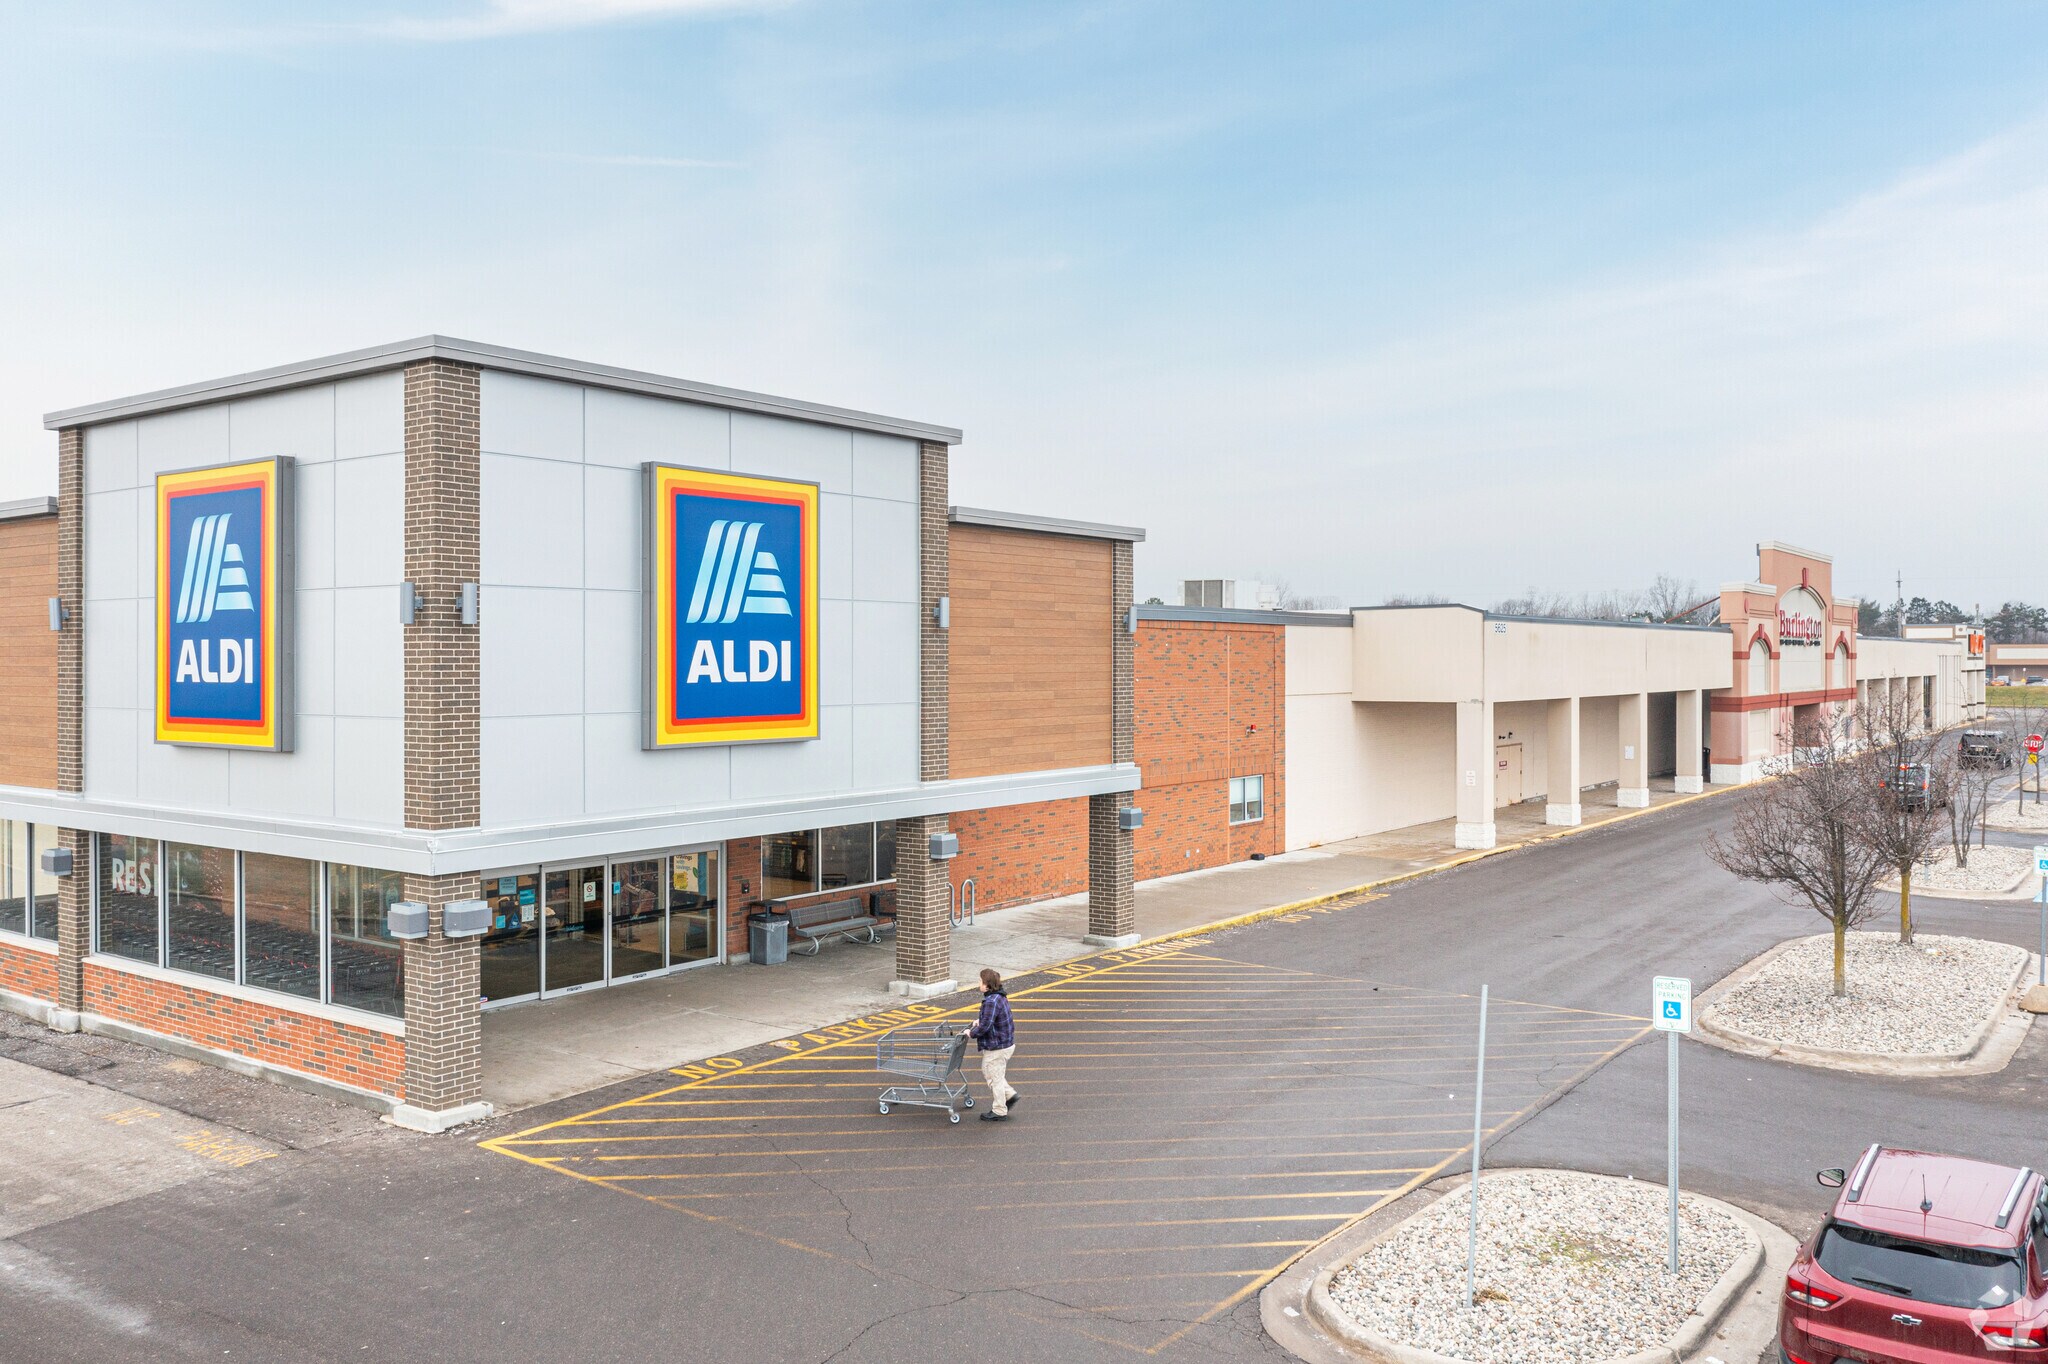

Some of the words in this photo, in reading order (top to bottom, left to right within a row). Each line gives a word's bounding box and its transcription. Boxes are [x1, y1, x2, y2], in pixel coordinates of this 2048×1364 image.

[1779, 609, 1822, 642] Burlington
[175, 638, 254, 684] ALDI
[686, 639, 792, 684] ALDI
[1656, 981, 1688, 992] RESERVED
[1658, 990, 1687, 1000] PARKING
[668, 1057, 743, 1080] NO
[769, 1004, 946, 1052] PARKING
